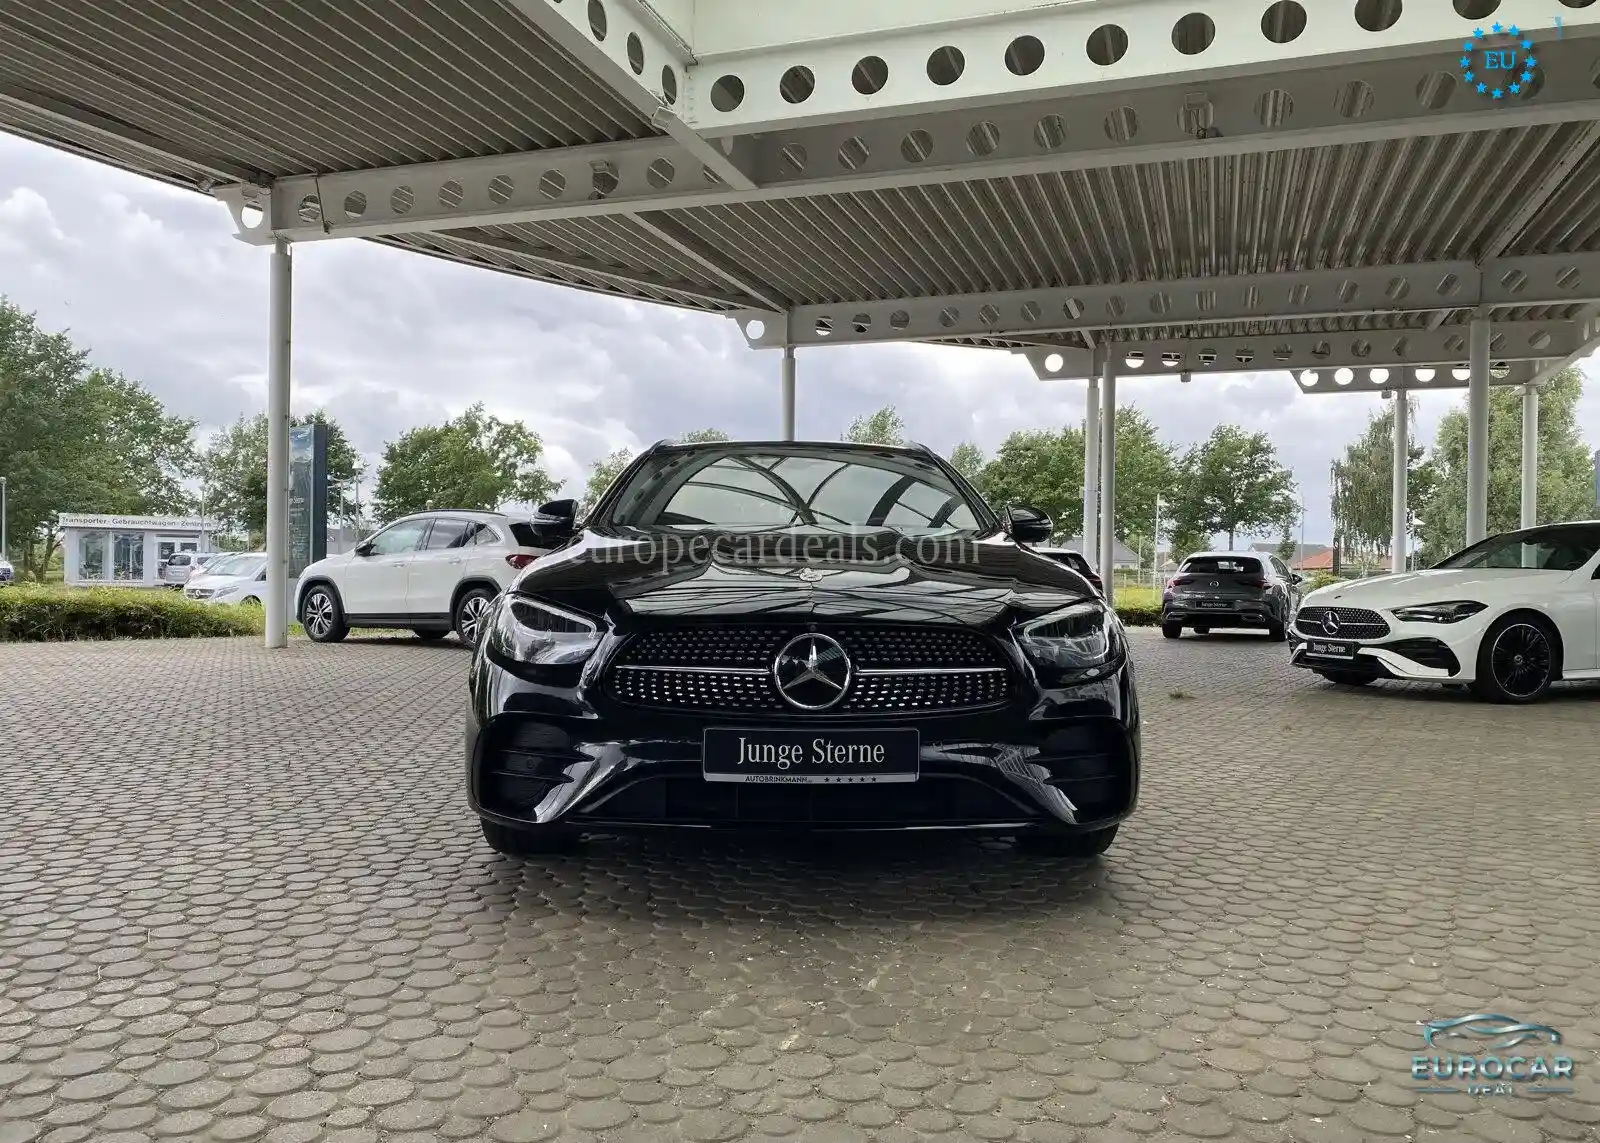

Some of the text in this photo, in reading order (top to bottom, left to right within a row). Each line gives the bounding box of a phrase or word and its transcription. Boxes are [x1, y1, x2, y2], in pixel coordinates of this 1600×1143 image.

[1327, 643, 1346, 653] Sterne
[737, 737, 885, 770] Junge Sterne
[745, 775, 808, 783] AUTOBRINKMANN
